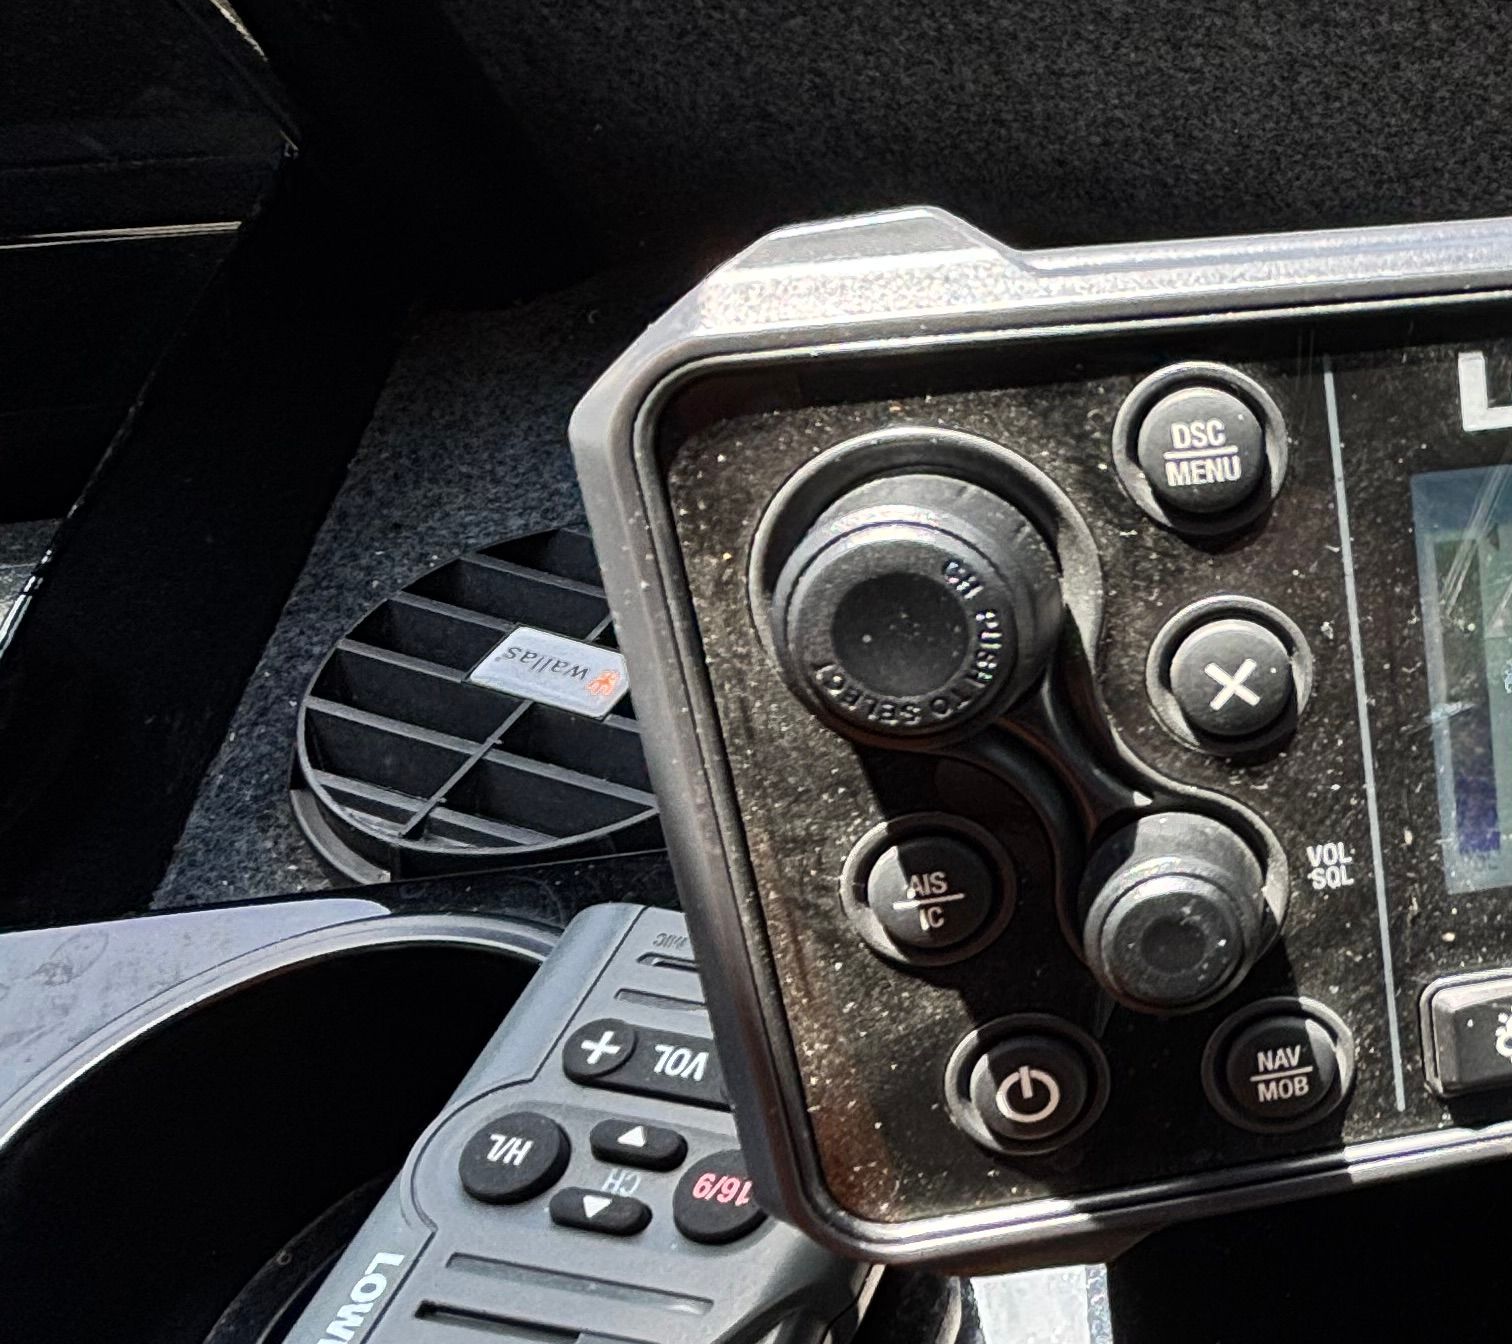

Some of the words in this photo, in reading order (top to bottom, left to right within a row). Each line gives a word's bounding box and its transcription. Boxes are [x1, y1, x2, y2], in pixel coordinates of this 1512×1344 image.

[1170, 417, 1227, 449] DSC
[1164, 454, 1242, 487] MENU
[503, 645, 592, 682] wallas
[964, 608, 1003, 689] PUSH
[809, 662, 923, 726] SELECT
[930, 688, 973, 720] TO
[1306, 841, 1353, 868] VOL
[906, 871, 948, 900] AIS
[919, 906, 946, 932] IC
[653, 1043, 710, 1083] VOL
[1256, 1043, 1302, 1073] NAV
[1256, 1076, 1310, 1103] MOB
[486, 1132, 534, 1167] H/L
[600, 1167, 642, 1197] CH
[691, 1172, 754, 1207] 16/9
